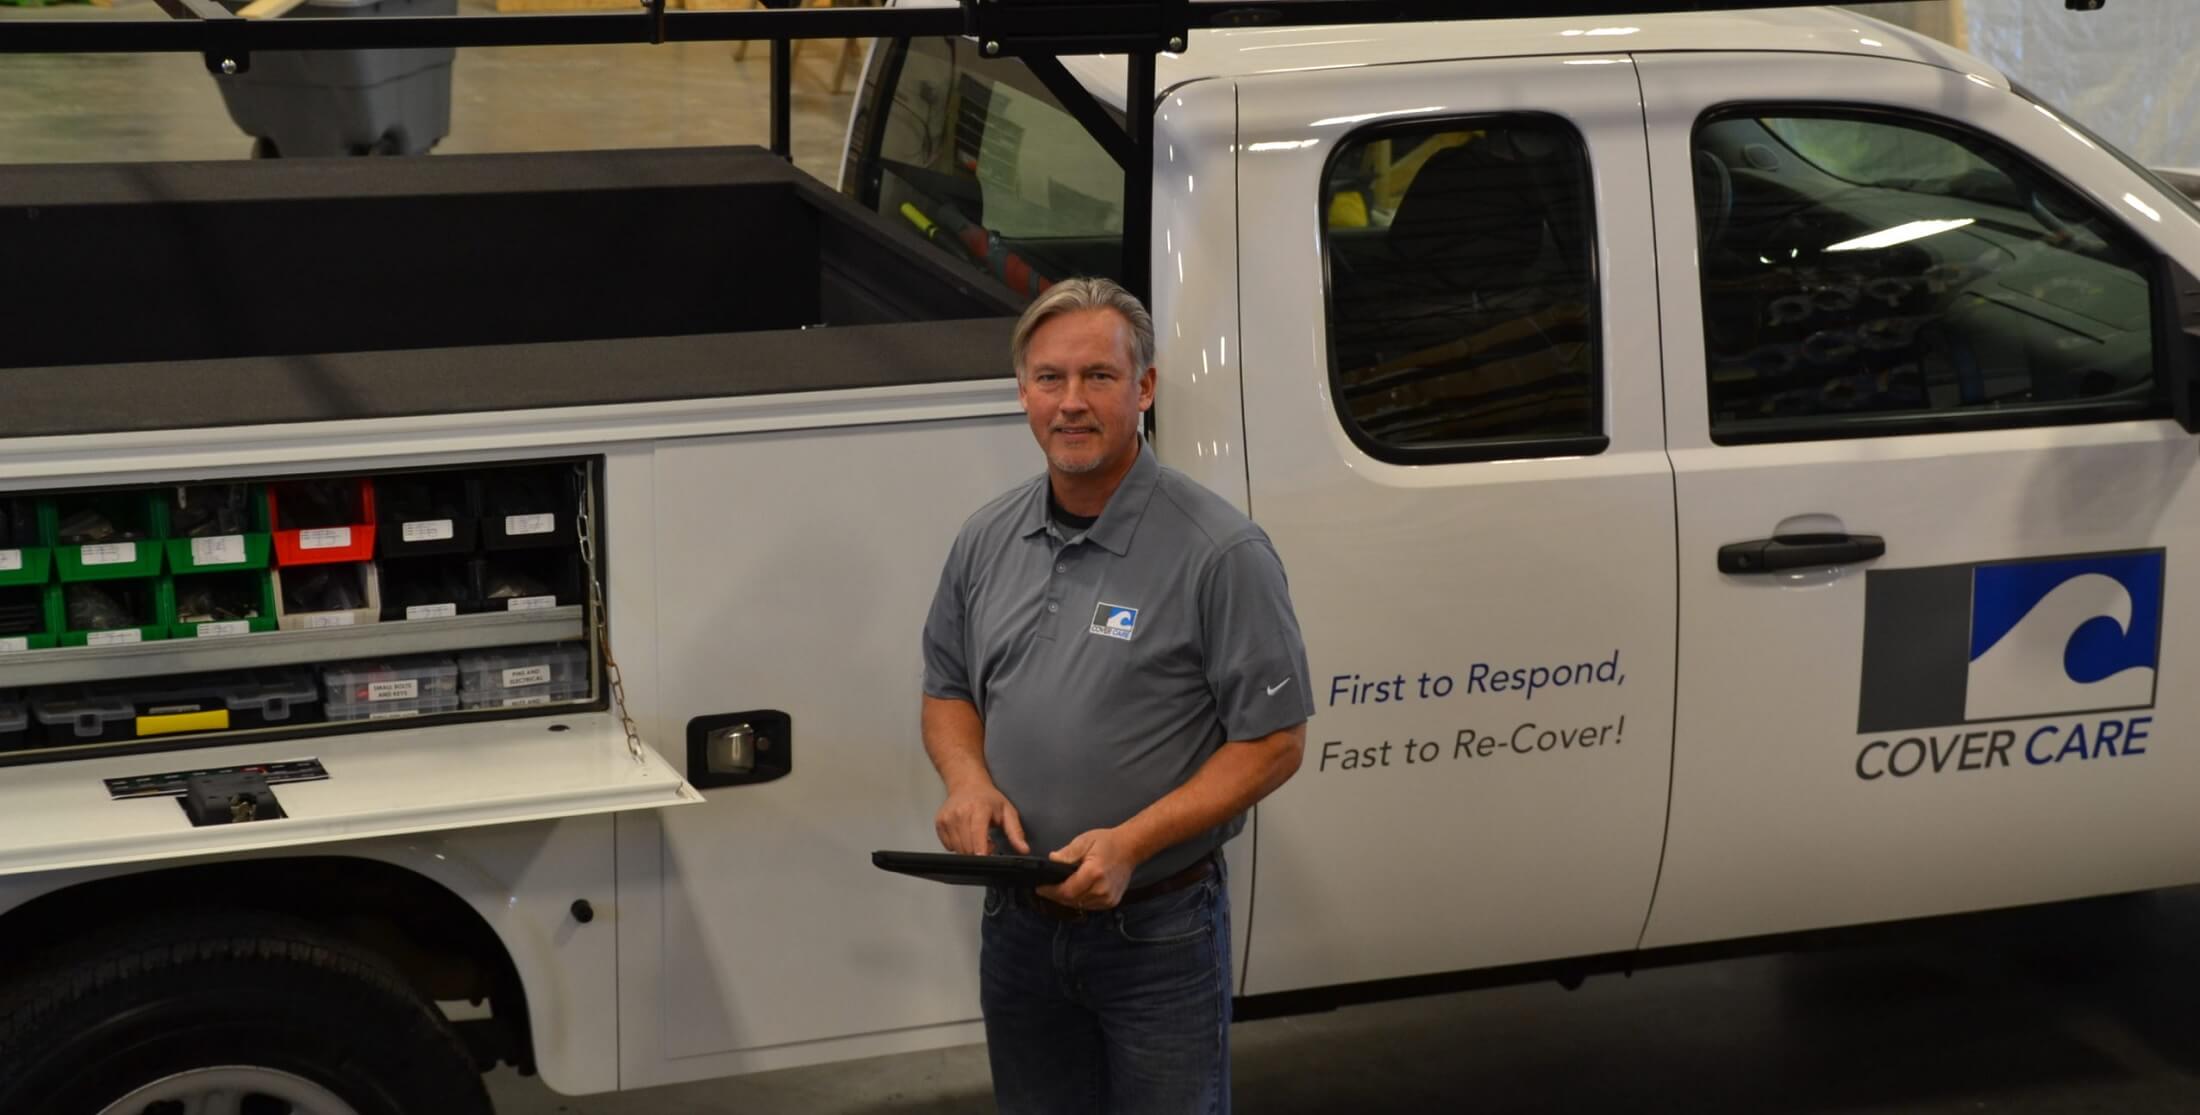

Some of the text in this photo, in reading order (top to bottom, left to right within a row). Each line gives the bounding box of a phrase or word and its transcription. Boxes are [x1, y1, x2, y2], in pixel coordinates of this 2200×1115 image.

[1328, 648, 1627, 708] First to Respond,
[1319, 714, 1625, 773] Fast to Re-Cover!
[1854, 715, 2155, 782] COVER CARE
